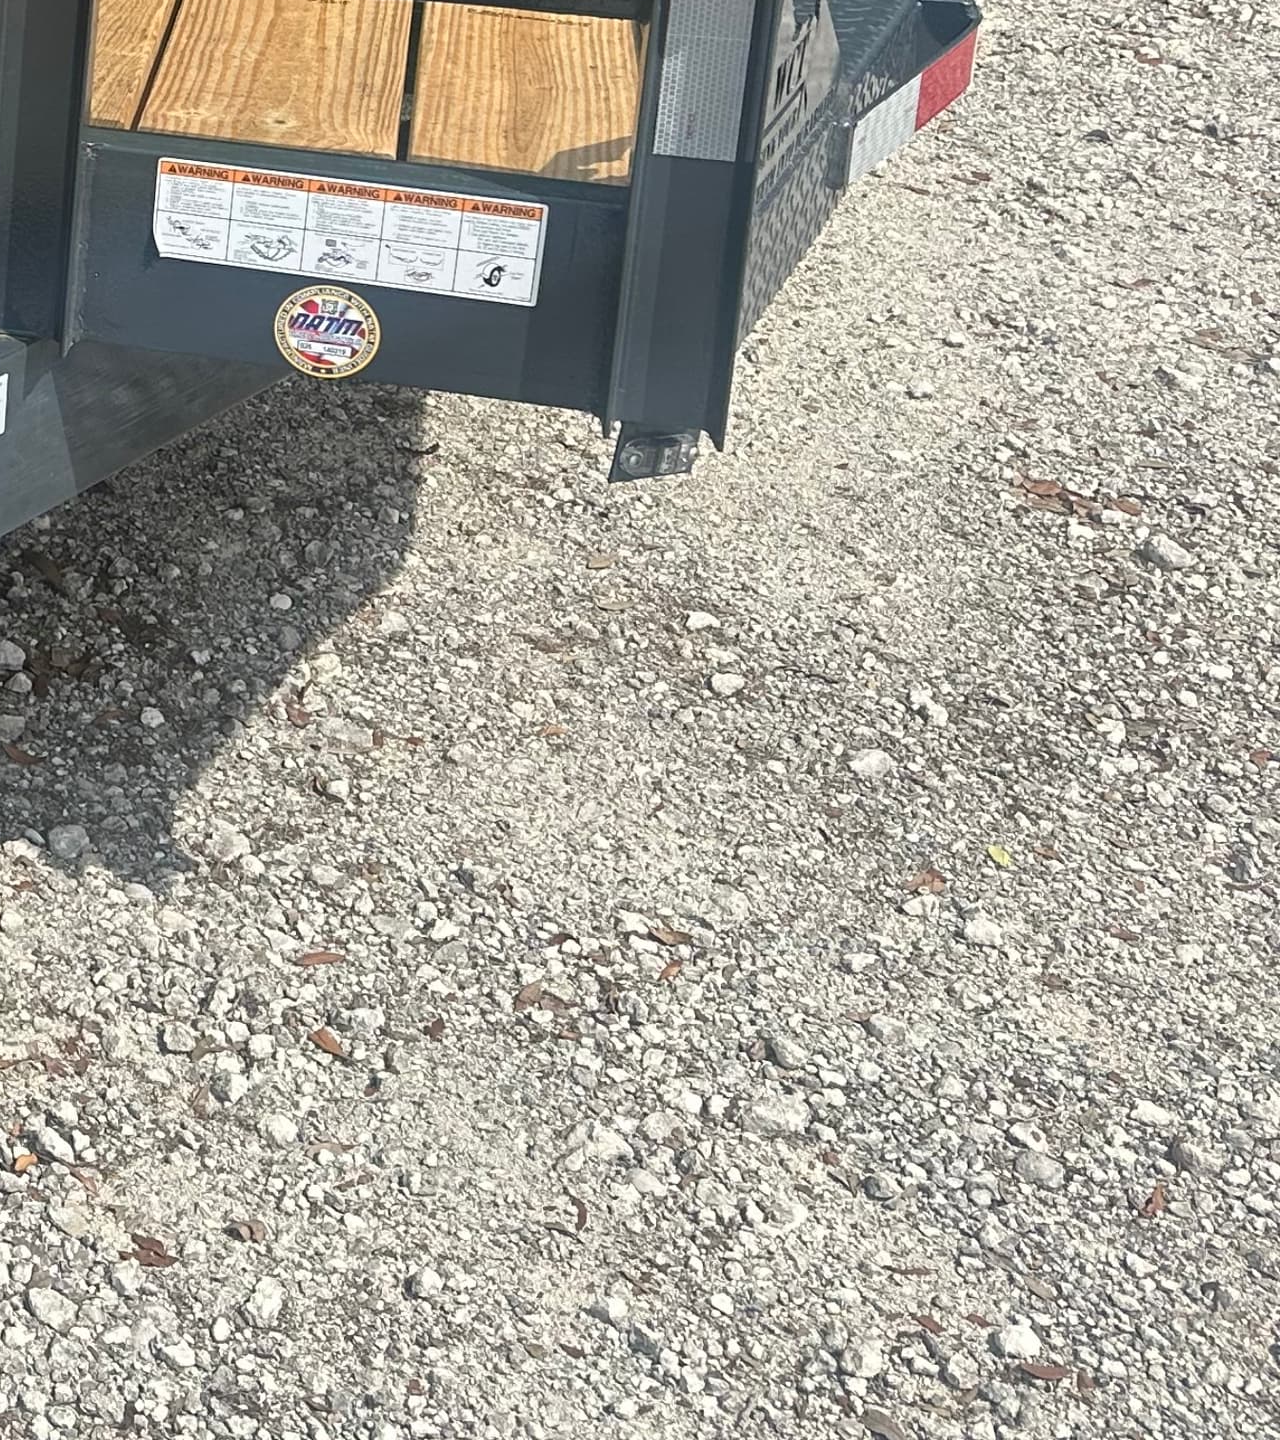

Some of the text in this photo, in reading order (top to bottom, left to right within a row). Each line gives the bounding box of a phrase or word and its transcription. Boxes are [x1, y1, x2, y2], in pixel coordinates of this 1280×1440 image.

[178, 162, 229, 180] WARNING
[252, 174, 304, 189] WARNING
[327, 184, 380, 199] WARNING
[403, 193, 458, 209] WARNING
[482, 202, 537, 218] WARNING
